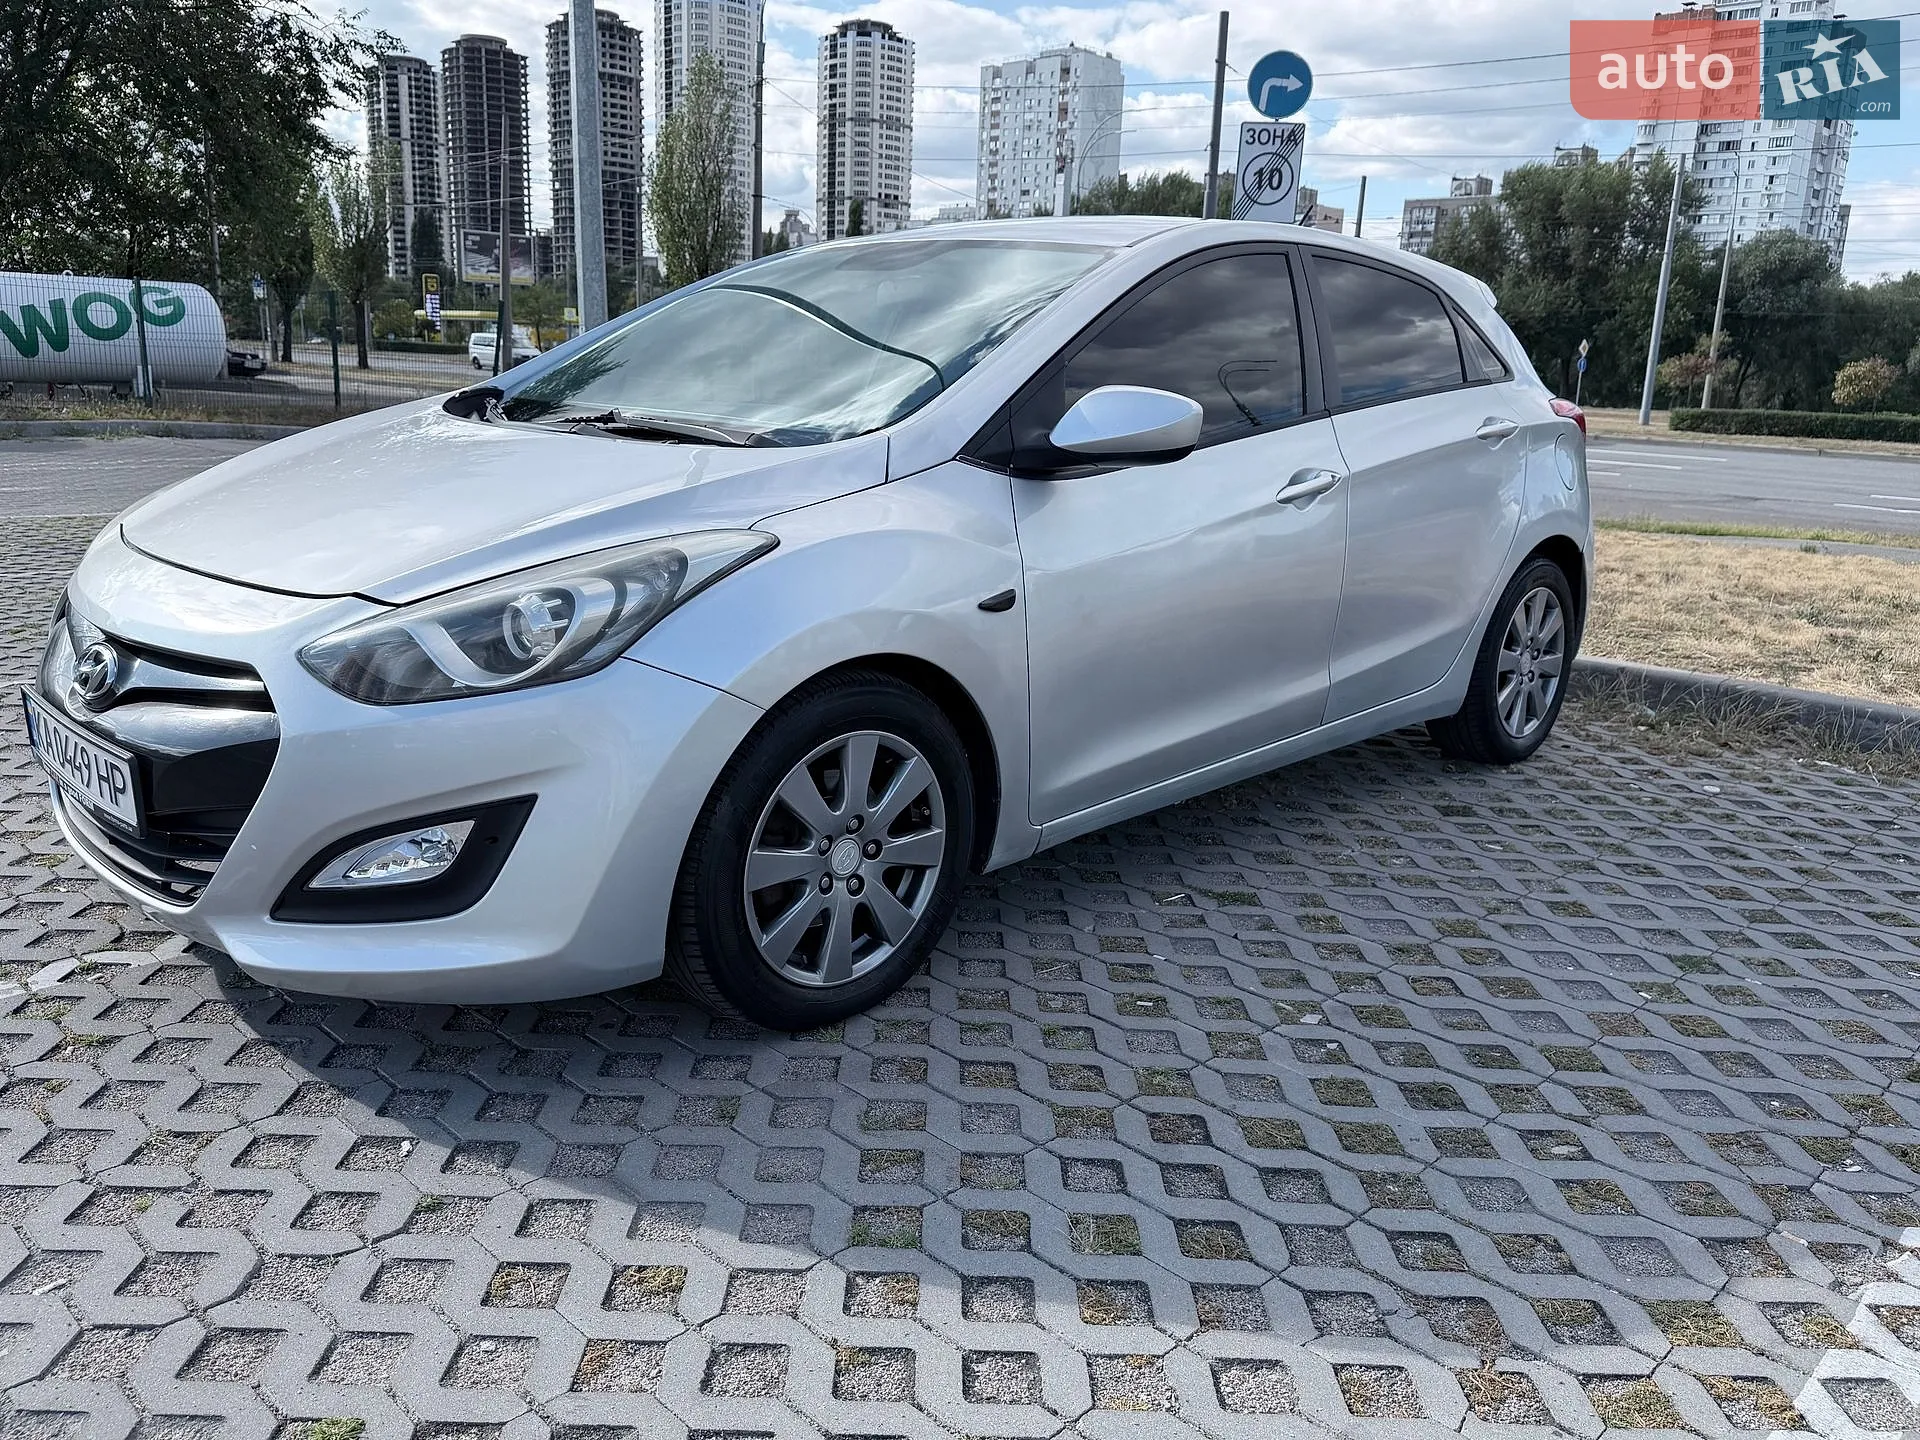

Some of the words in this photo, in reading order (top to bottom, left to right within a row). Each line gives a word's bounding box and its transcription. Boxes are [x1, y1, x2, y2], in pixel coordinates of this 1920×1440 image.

[1245, 128, 1298, 146] ЗОНА
[1253, 167, 1283, 190] 10
[0, 285, 186, 359] WOG
